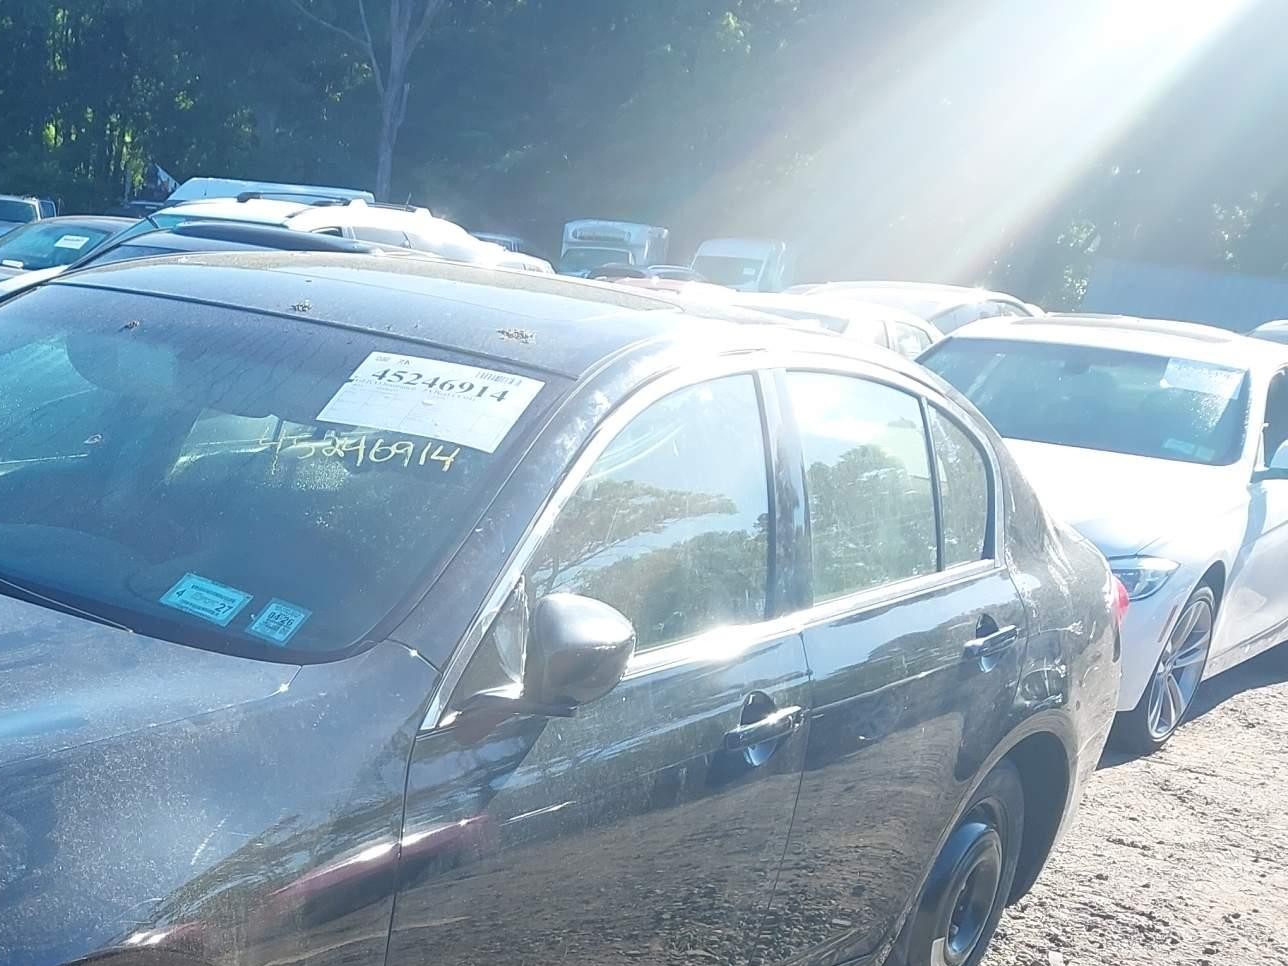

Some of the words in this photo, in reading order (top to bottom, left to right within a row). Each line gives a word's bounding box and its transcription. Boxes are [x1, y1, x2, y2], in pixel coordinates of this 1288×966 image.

[372, 367, 509, 402] 45246914
[259, 428, 461, 472] 45246914
[176, 589, 186, 598] 4
[214, 602, 233, 614] 27
